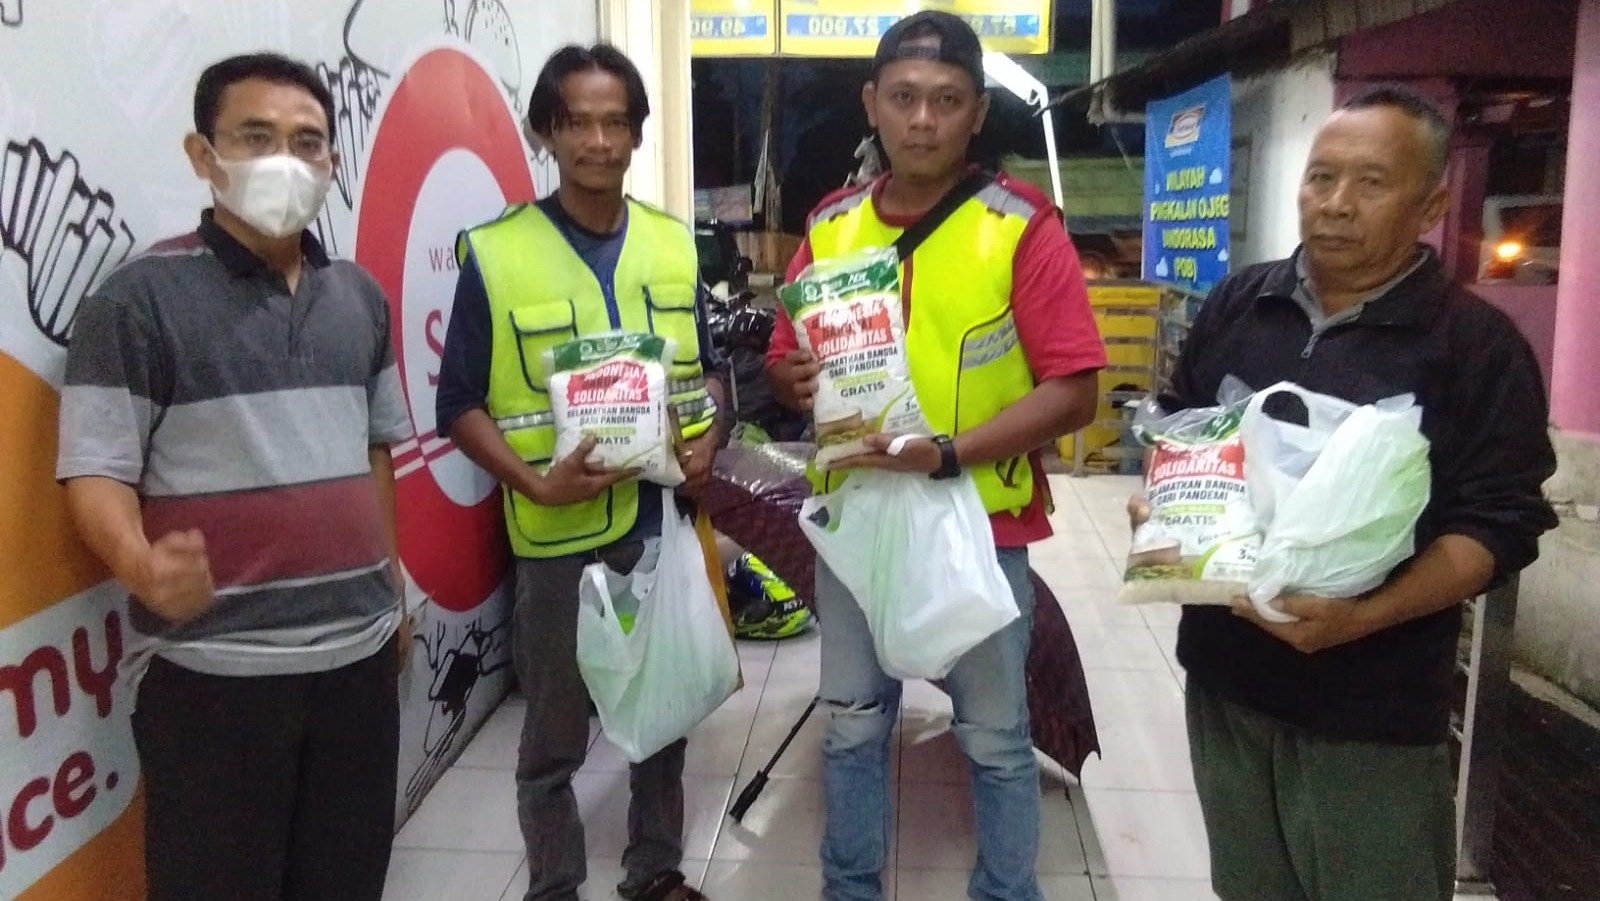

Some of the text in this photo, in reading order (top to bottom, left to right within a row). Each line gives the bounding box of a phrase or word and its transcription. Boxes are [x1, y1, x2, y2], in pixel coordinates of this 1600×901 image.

[849, 358, 887, 374] PANDEMI
[840, 380, 885, 397] GRATIS
[573, 389, 642, 405] SOLIDARITAS
[600, 414, 638, 424] PANDEMI
[595, 436, 631, 445] RATIS
[1153, 460, 1237, 482] SOLIDARITAS
[1178, 490, 1228, 502] PANDEMI
[1164, 515, 1217, 526] GRATIS
